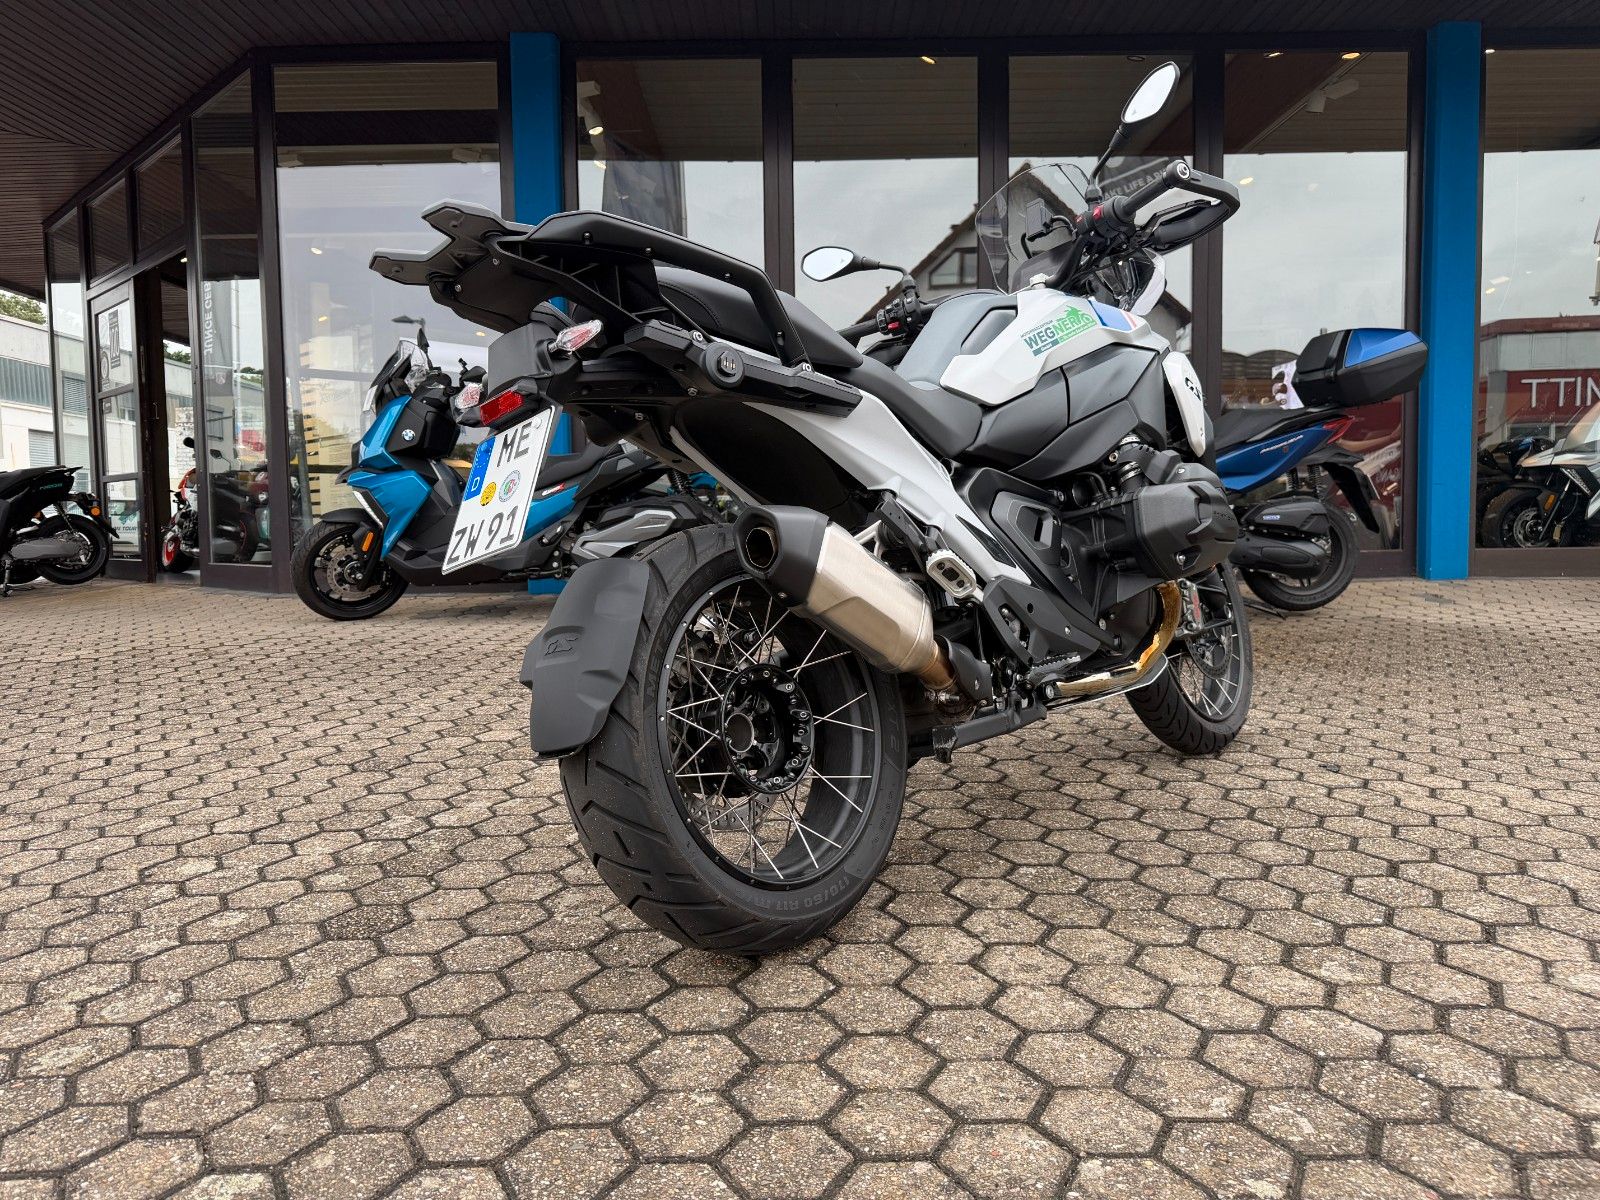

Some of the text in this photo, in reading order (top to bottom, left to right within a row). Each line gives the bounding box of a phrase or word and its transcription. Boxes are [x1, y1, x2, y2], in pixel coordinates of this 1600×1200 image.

[1104, 187, 1122, 200] AKE
[1123, 178, 1146, 193] LIFE
[1023, 314, 1081, 350] WEGNER
[497, 420, 533, 467] ME
[471, 476, 480, 492] D
[446, 505, 519, 566] ZW 91
